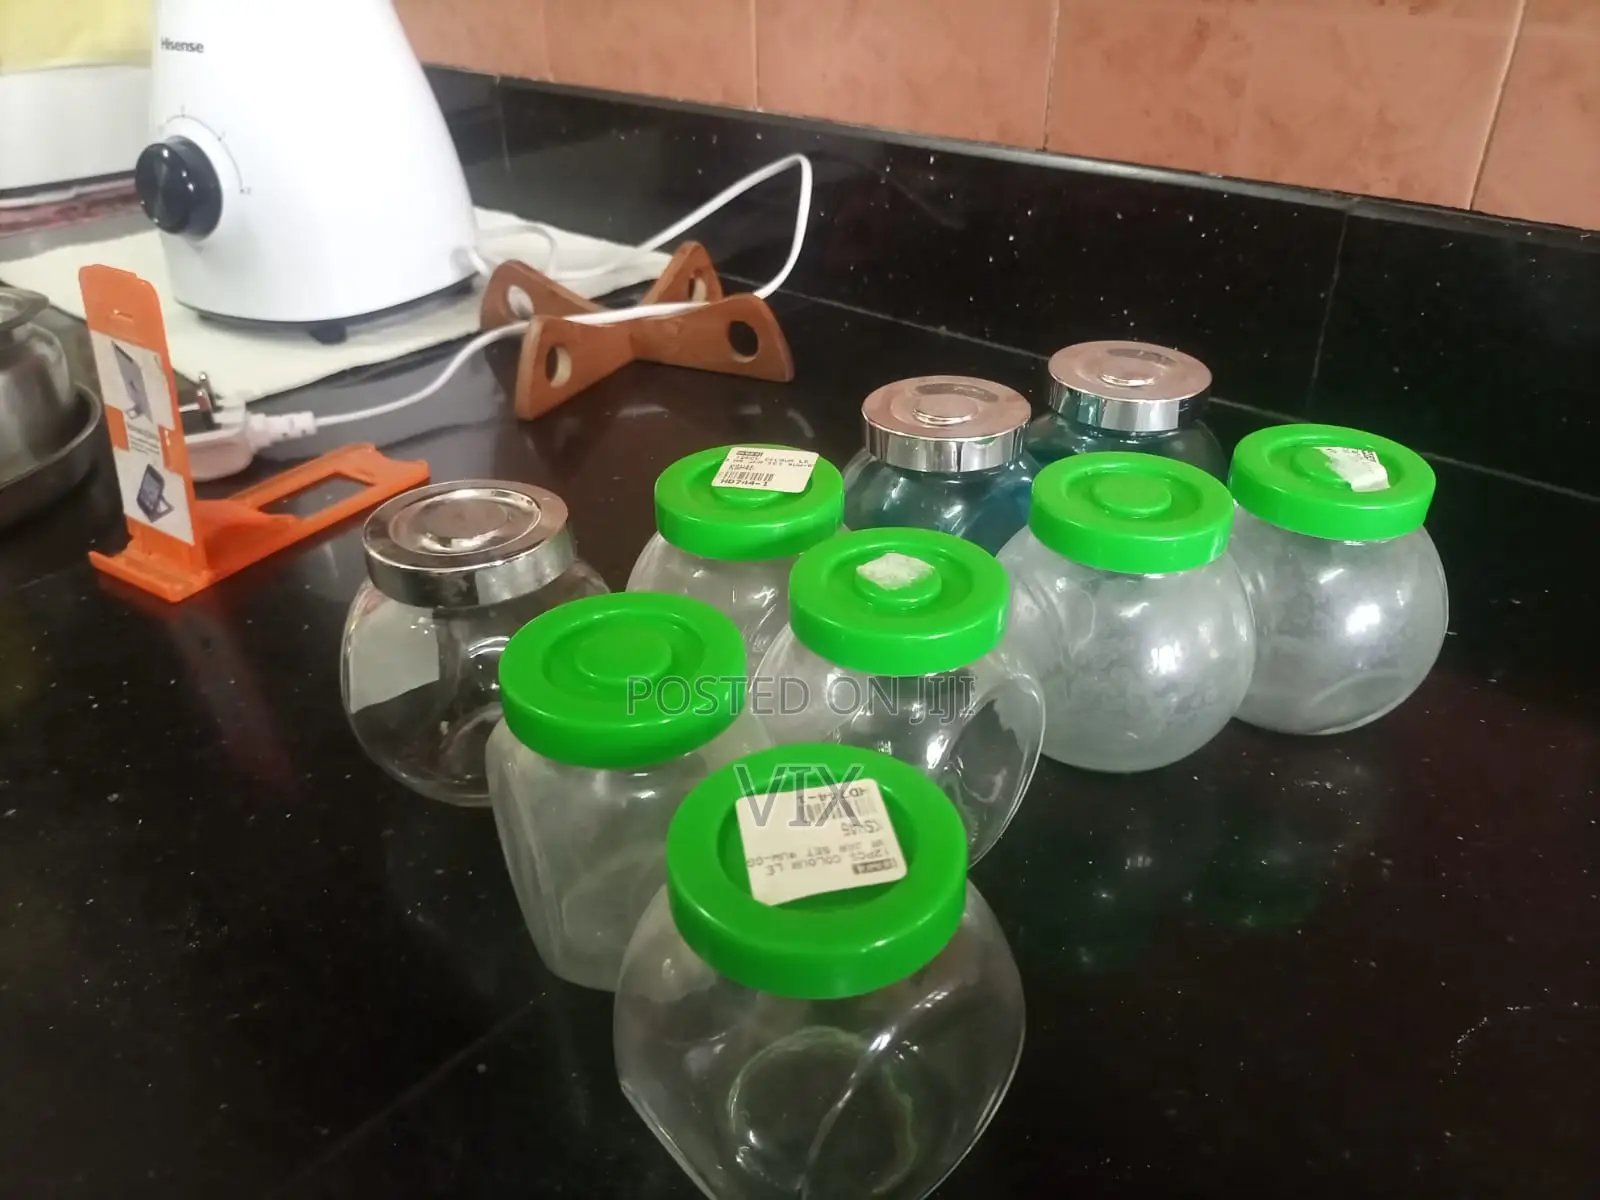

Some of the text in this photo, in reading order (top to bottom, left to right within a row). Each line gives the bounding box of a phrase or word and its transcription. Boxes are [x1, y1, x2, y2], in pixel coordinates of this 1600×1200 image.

[160, 36, 205, 53] Hisense
[806, 846, 832, 858] SET
[766, 863, 784, 876] LE
